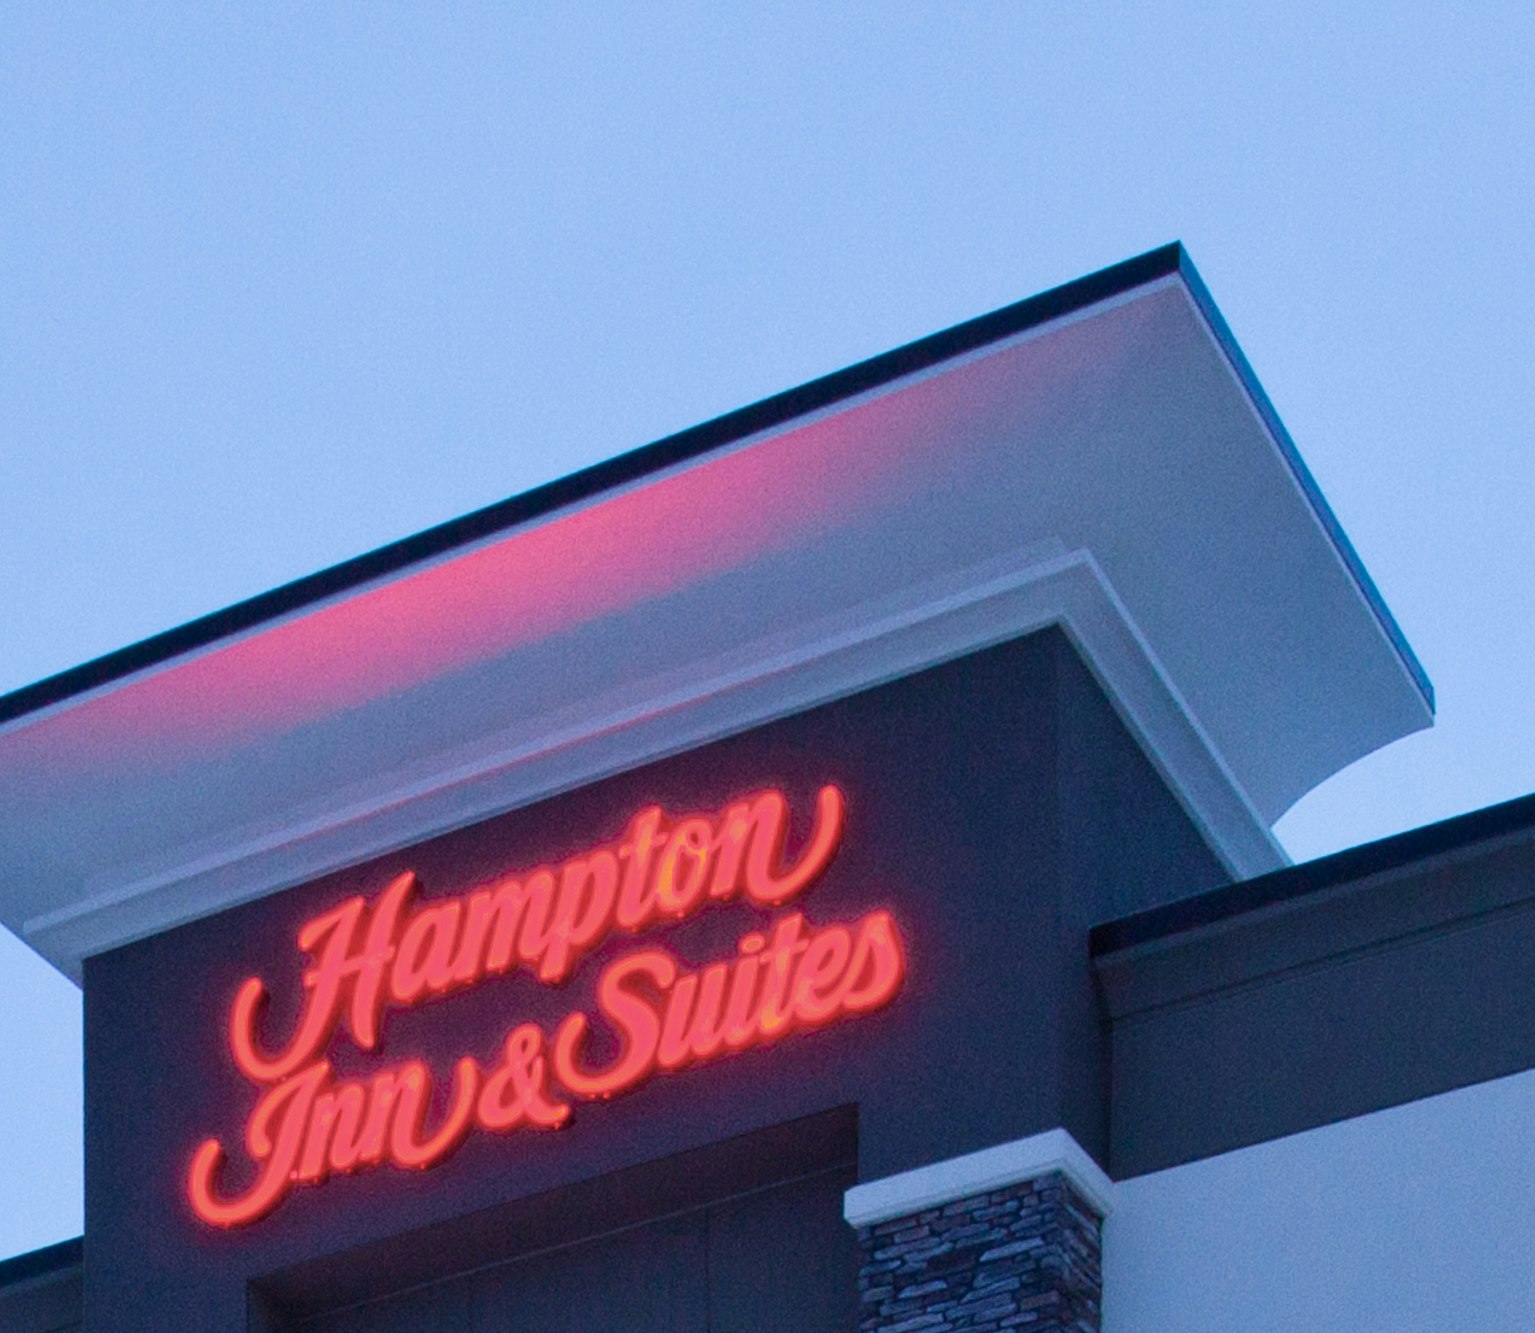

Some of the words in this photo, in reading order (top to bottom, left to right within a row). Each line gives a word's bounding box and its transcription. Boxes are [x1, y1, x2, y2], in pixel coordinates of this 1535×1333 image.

[189, 1060, 475, 1227] Inn
[477, 1023, 570, 1129] &
[555, 911, 905, 1097] Suites
[230, 784, 845, 1080] Hampton
